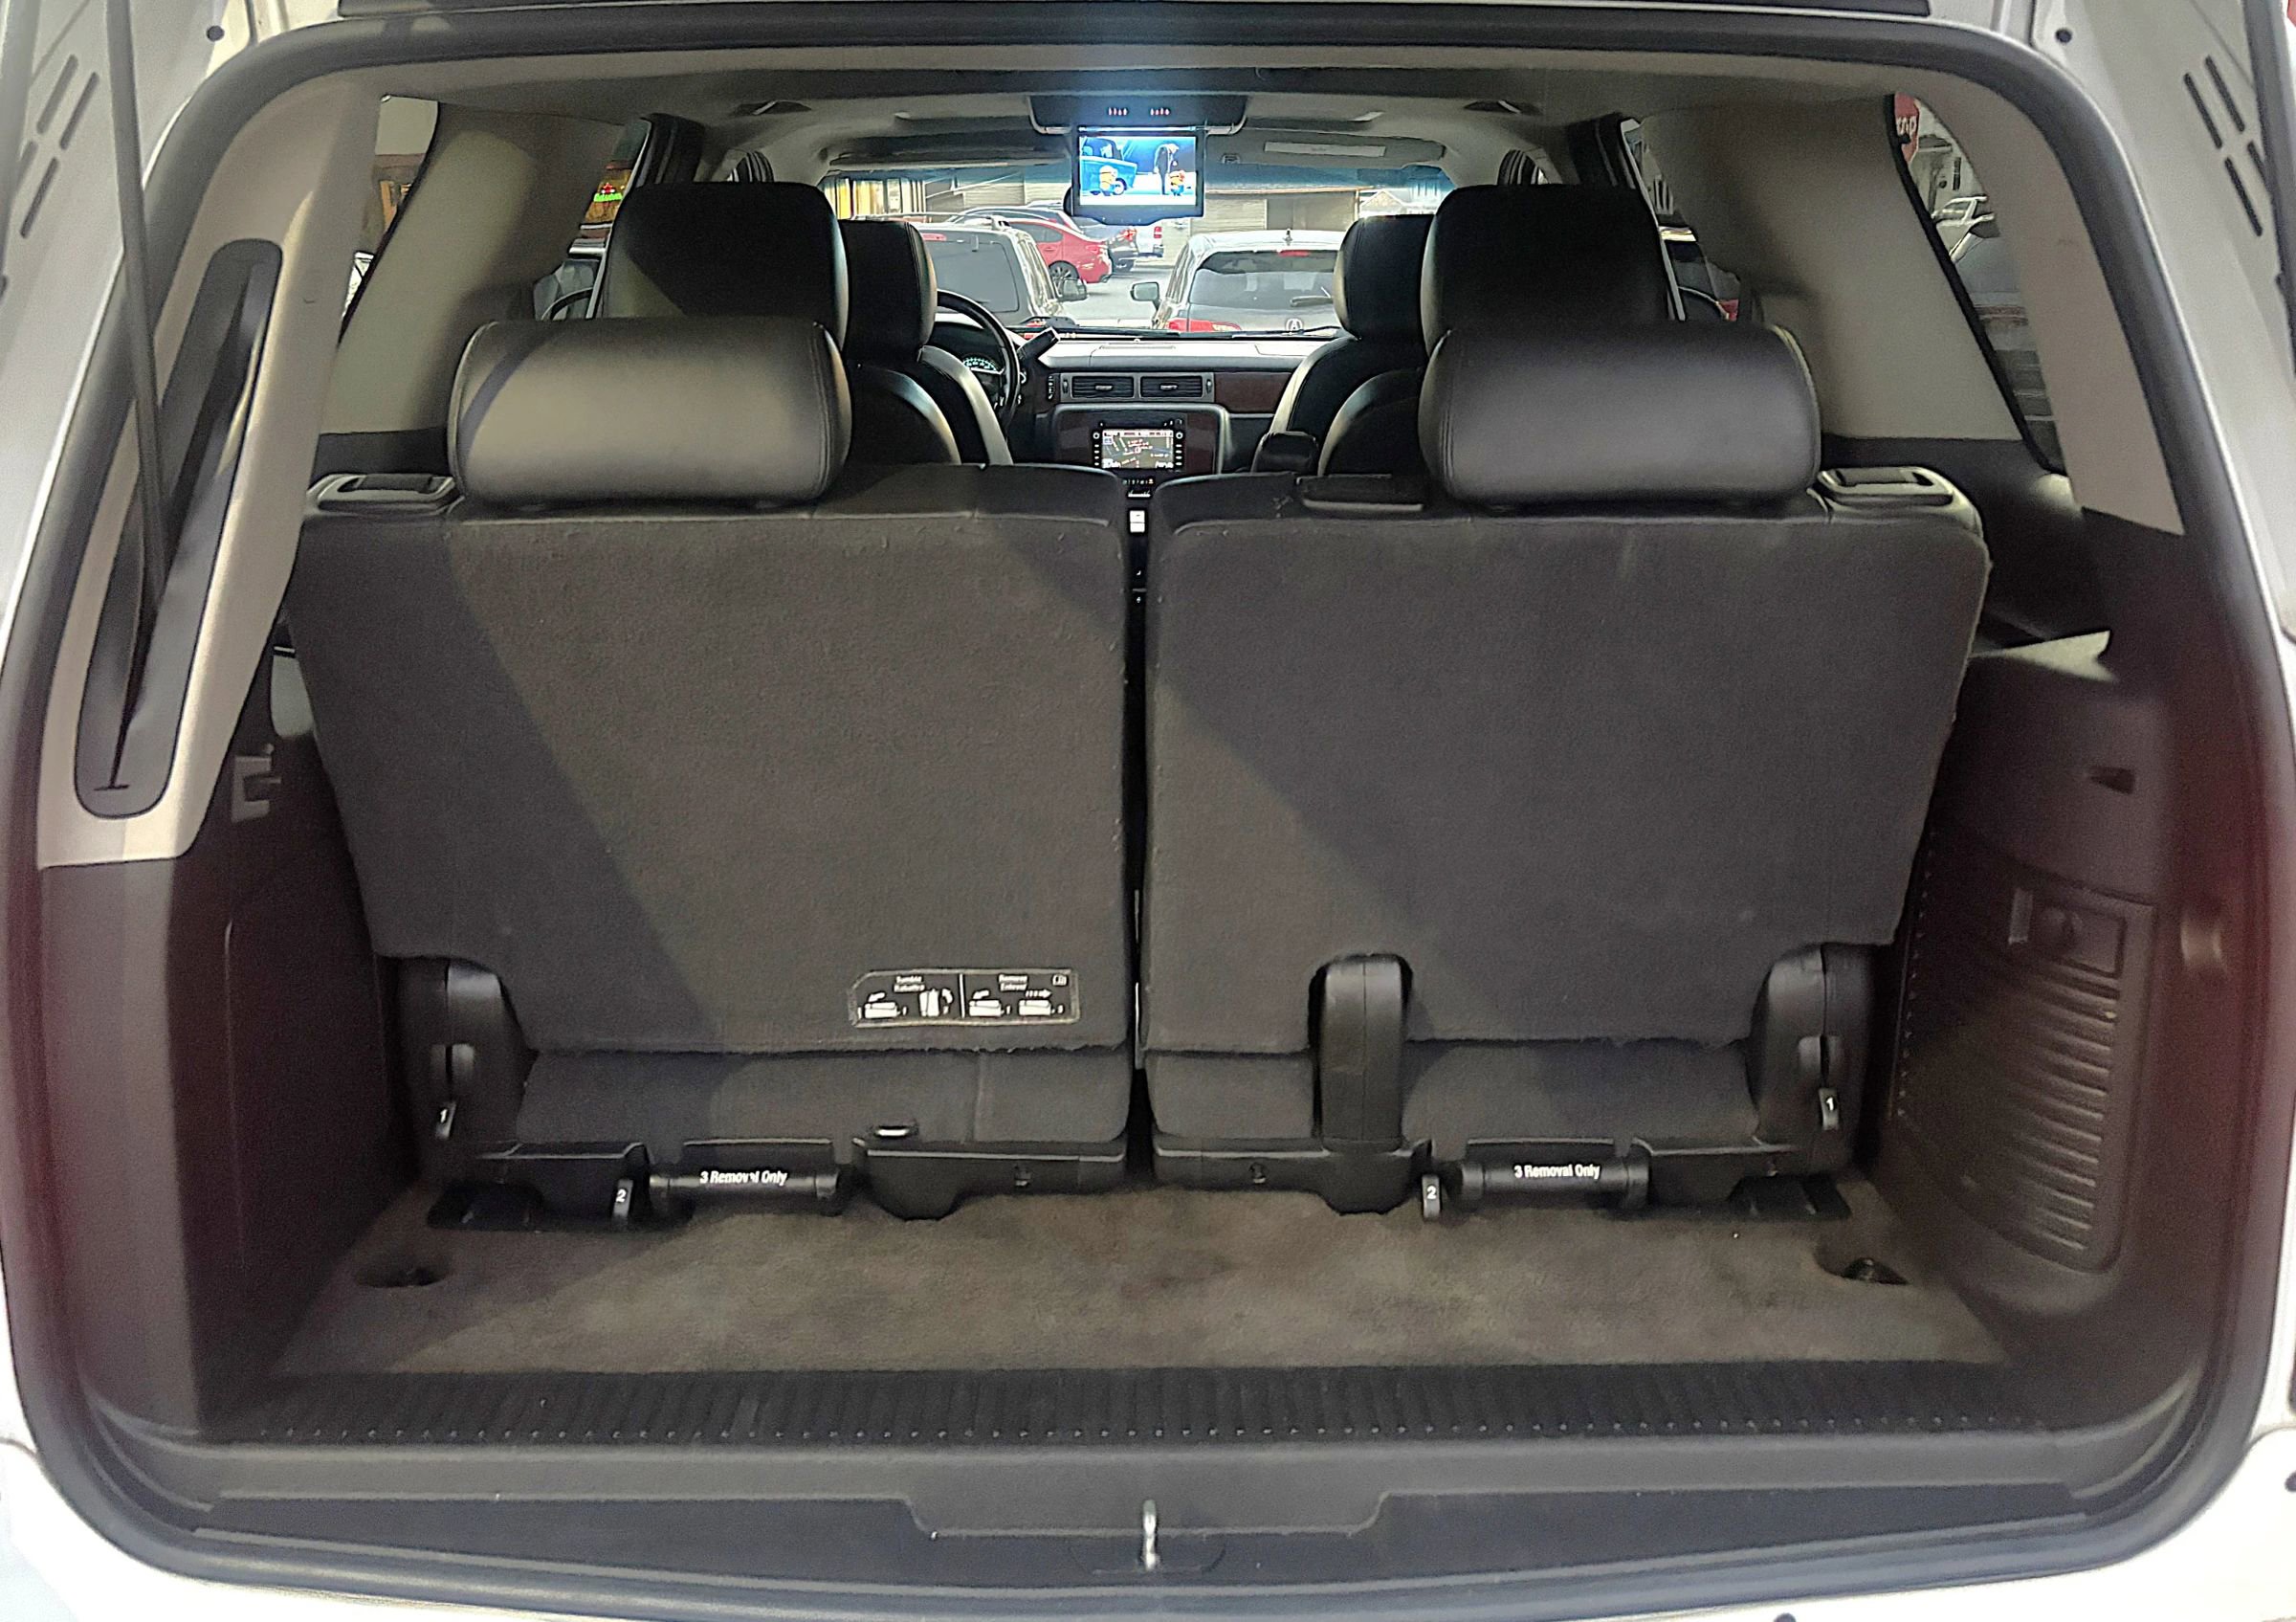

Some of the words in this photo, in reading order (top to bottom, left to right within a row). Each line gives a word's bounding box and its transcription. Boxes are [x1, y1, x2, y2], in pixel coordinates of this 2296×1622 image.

[1825, 1097, 1835, 1111] 1
[440, 1108, 448, 1123] 1
[699, 1170, 709, 1184] 3
[762, 1169, 788, 1187] Only
[1513, 1165, 1523, 1178] 3
[1524, 1164, 1574, 1178] Removal
[1575, 1164, 1601, 1180] Only
[615, 1189, 627, 1203] 2
[1426, 1185, 1437, 1200] 2
